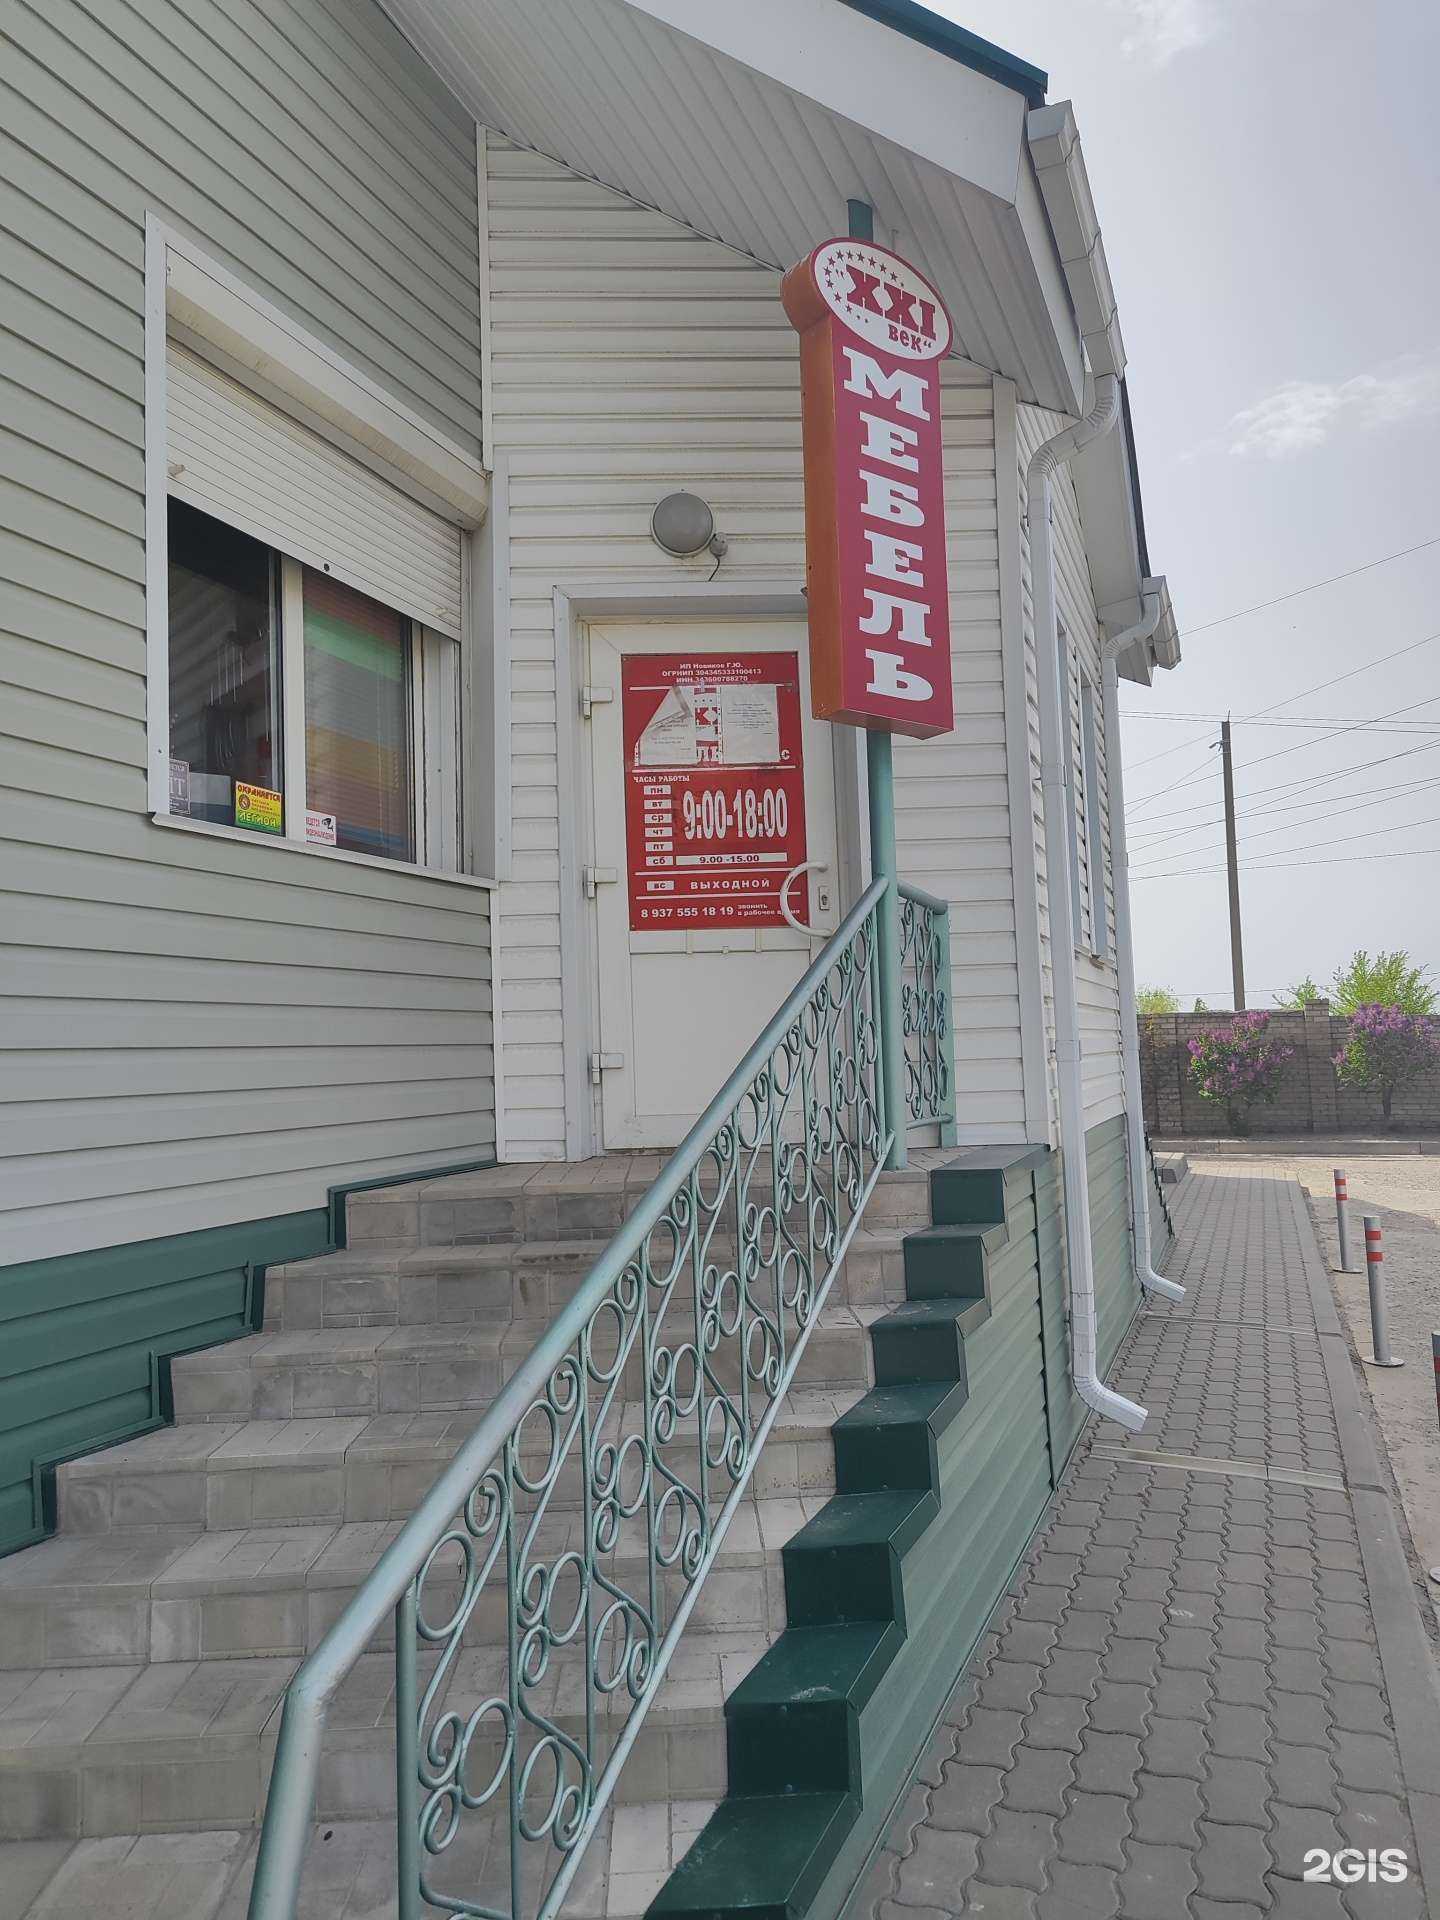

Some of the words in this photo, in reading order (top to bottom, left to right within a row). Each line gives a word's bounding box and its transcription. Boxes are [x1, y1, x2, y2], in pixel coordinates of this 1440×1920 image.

[842, 346, 934, 701] МЕБЕЛЬ
[239, 811, 276, 828] ЛЕГИОН
[683, 788, 787, 840] 9:00-18:00
[653, 857, 666, 865] сб
[641, 908, 649, 918] 8
[652, 908, 673, 917] 937
[677, 907, 698, 917] 555
[702, 906, 716, 916] 18
[720, 906, 734, 916] 19
